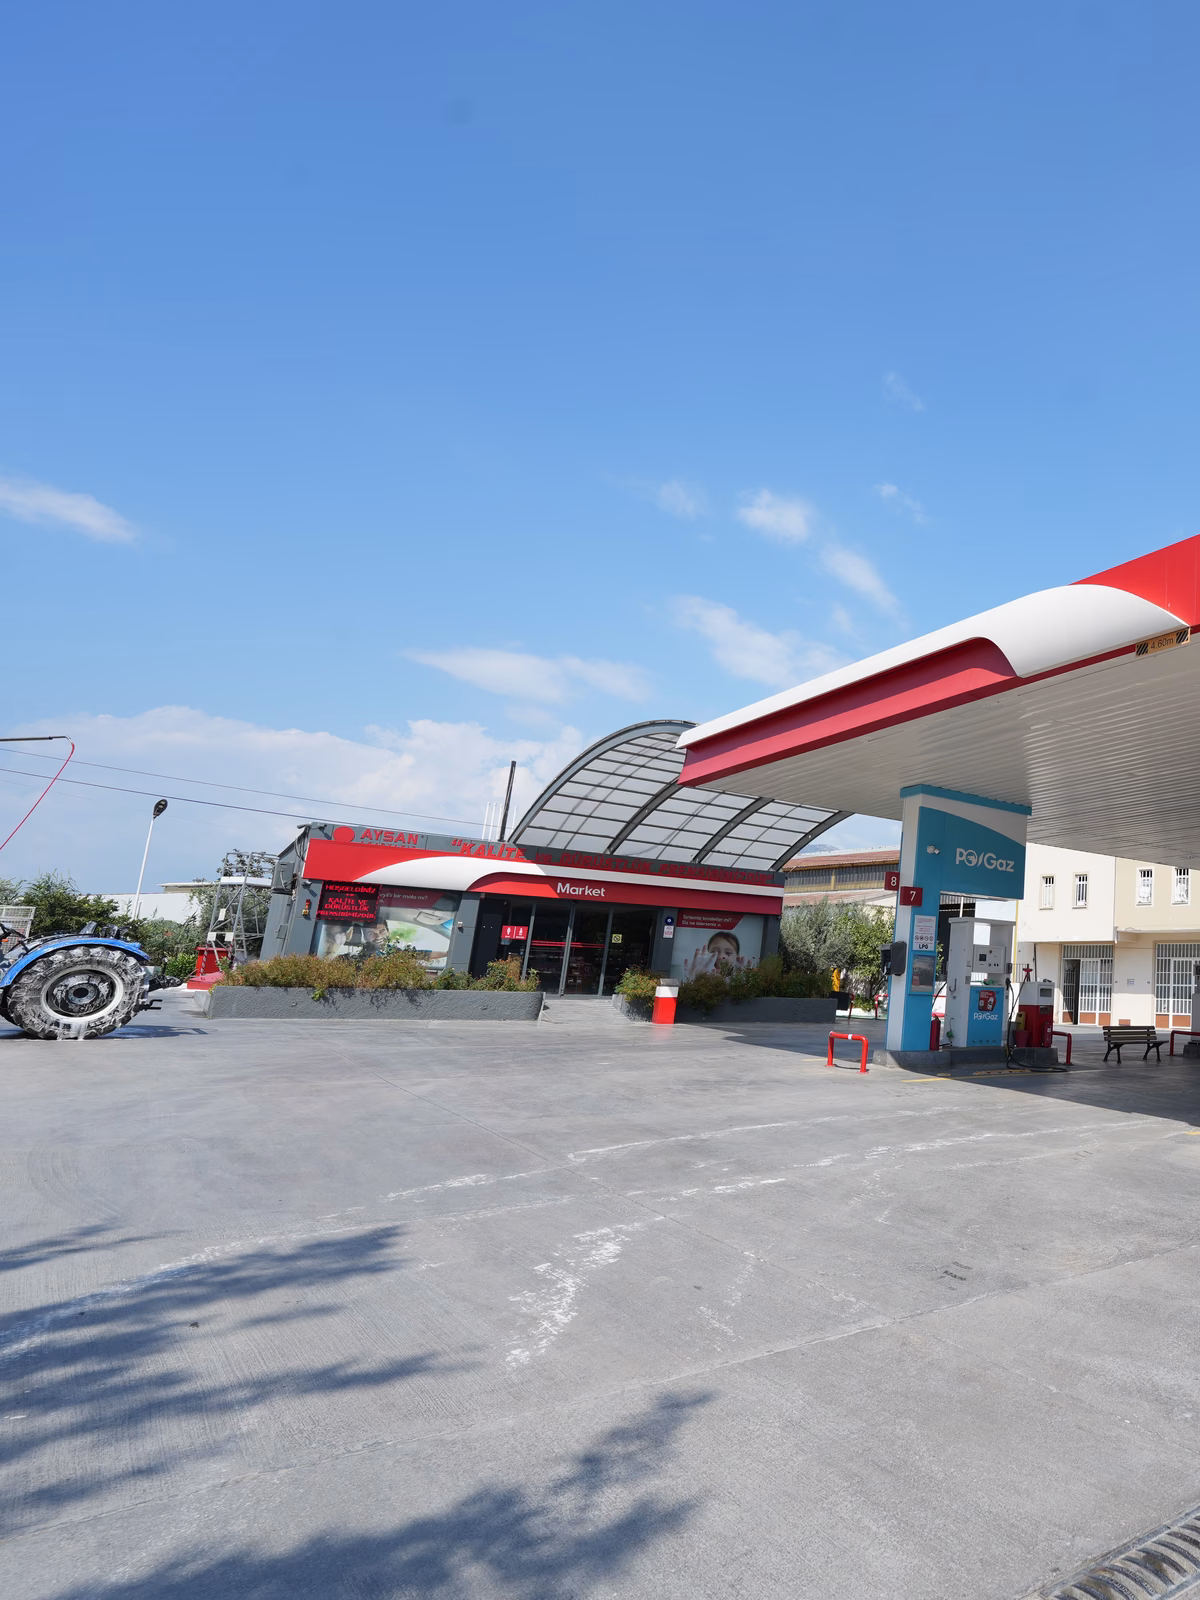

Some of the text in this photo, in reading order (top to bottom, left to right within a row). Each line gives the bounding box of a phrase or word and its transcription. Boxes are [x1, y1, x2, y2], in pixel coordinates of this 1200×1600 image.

[361, 828, 419, 845] AYSAN
[890, 876, 897, 886] 8
[556, 882, 606, 897] Market
[910, 890, 917, 901] 7
